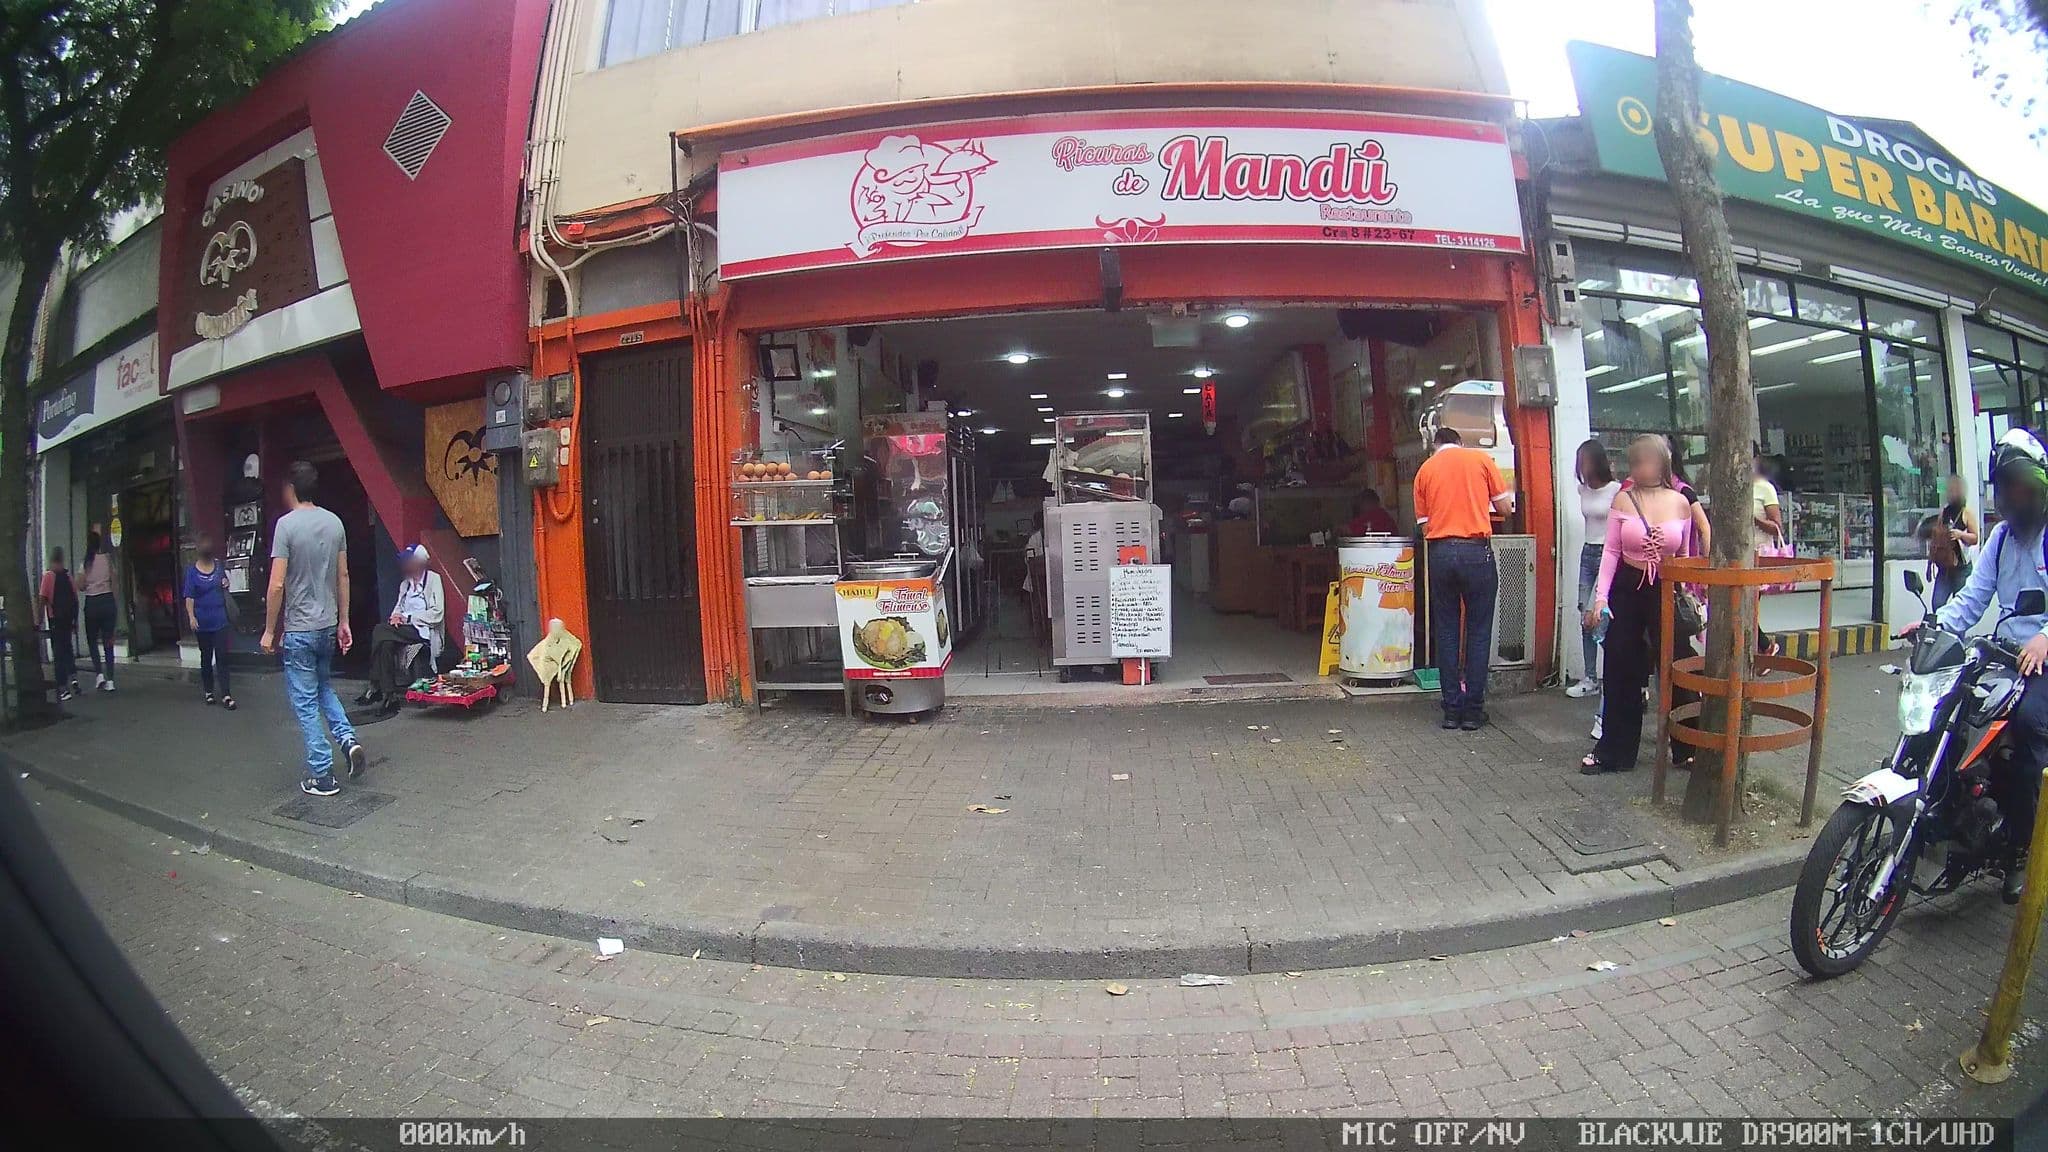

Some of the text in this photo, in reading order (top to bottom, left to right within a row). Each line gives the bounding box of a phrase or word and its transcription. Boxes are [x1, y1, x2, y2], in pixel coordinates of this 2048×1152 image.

[1052, 136, 1397, 204] Ricuras de Mandú
[1825, 115, 1997, 207] DROGAS
[1320, 203, 1413, 224] Restaurante
[1351, 228, 1360, 239] 8
[1374, 228, 1415, 241] 23-67
[1775, 188, 1822, 209] La
[1832, 205, 1874, 224] que
[1879, 214, 1934, 243] Más
[1939, 234, 2000, 267] Barato
[1907, 174, 2048, 273] BARAT
[876, 599, 930, 614] Tolimense
[892, 587, 929, 600] Tamal
